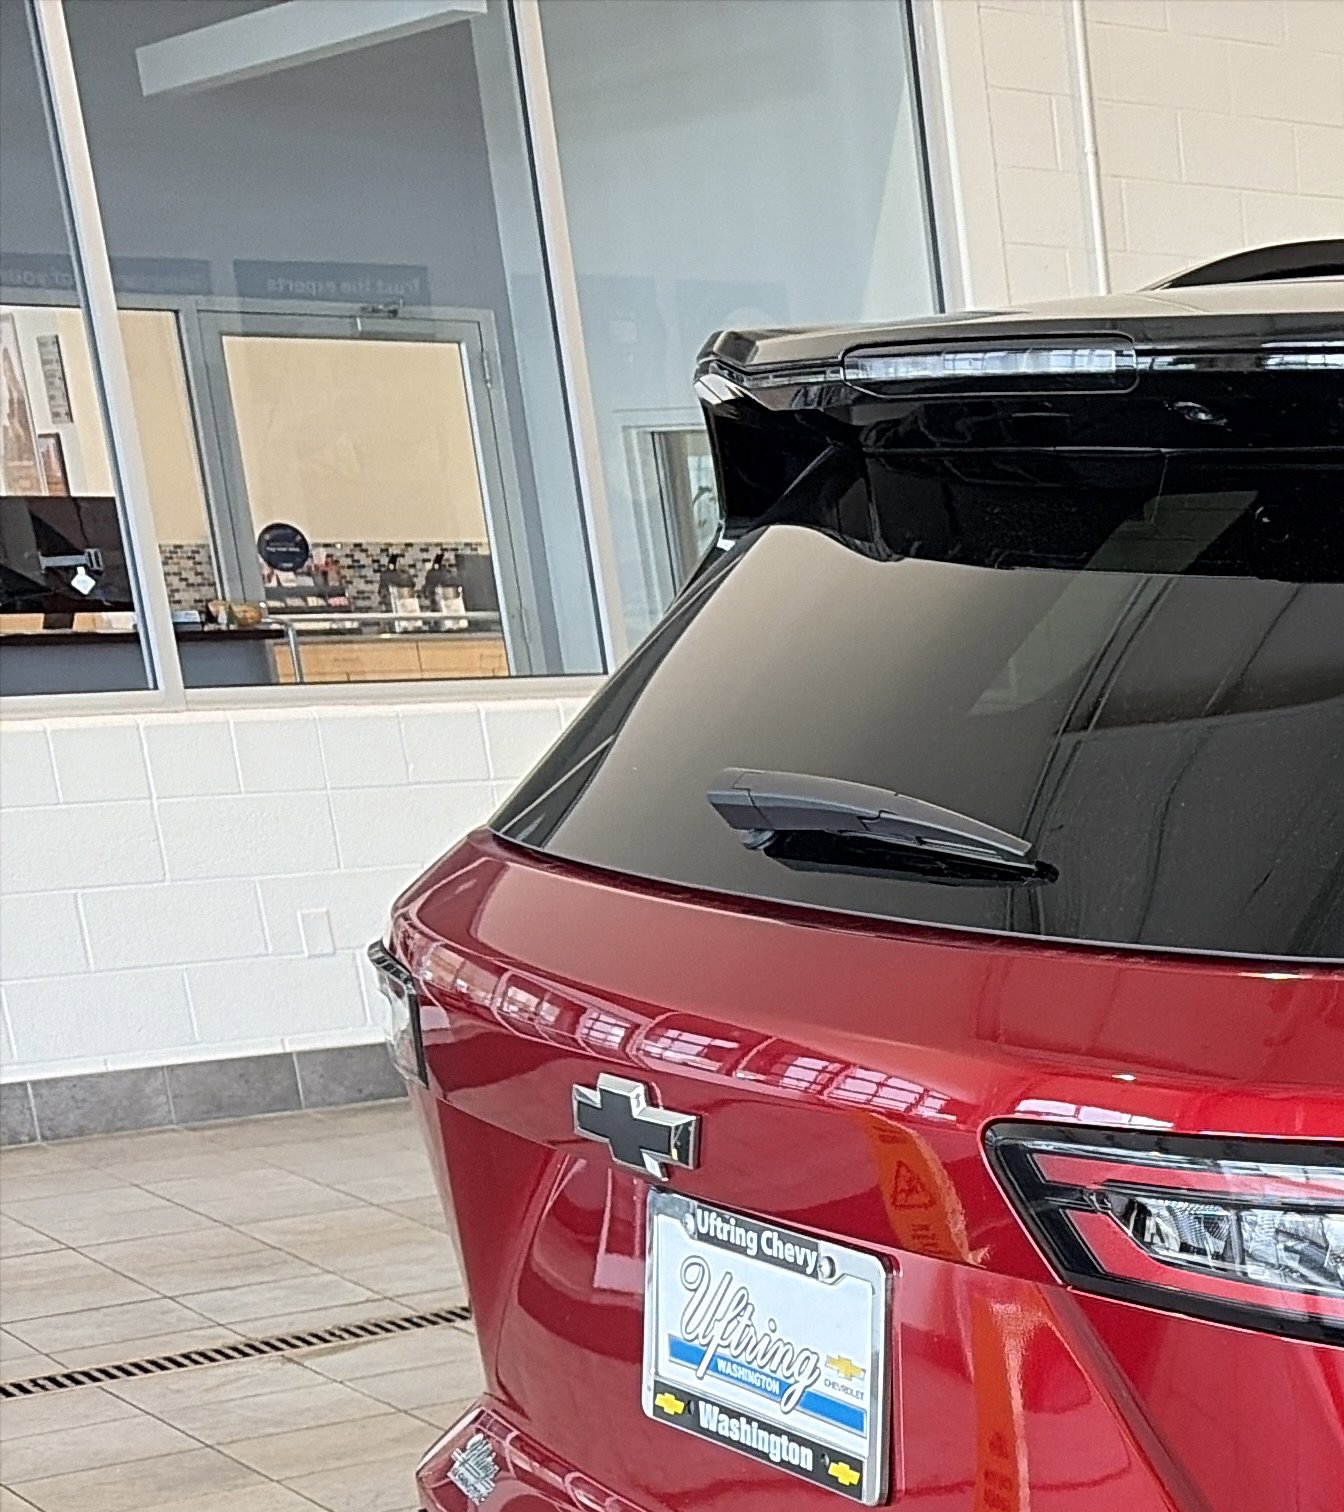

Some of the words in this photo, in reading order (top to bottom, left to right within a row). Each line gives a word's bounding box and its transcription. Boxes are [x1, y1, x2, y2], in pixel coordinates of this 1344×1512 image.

[696, 1208, 758, 1256] Uftring
[760, 1230, 818, 1275] Chevy
[680, 1255, 821, 1413] Uftring
[717, 1357, 780, 1395] WASHINGTON
[824, 1378, 865, 1400] CHEVROLET
[698, 1400, 814, 1472] Washington
